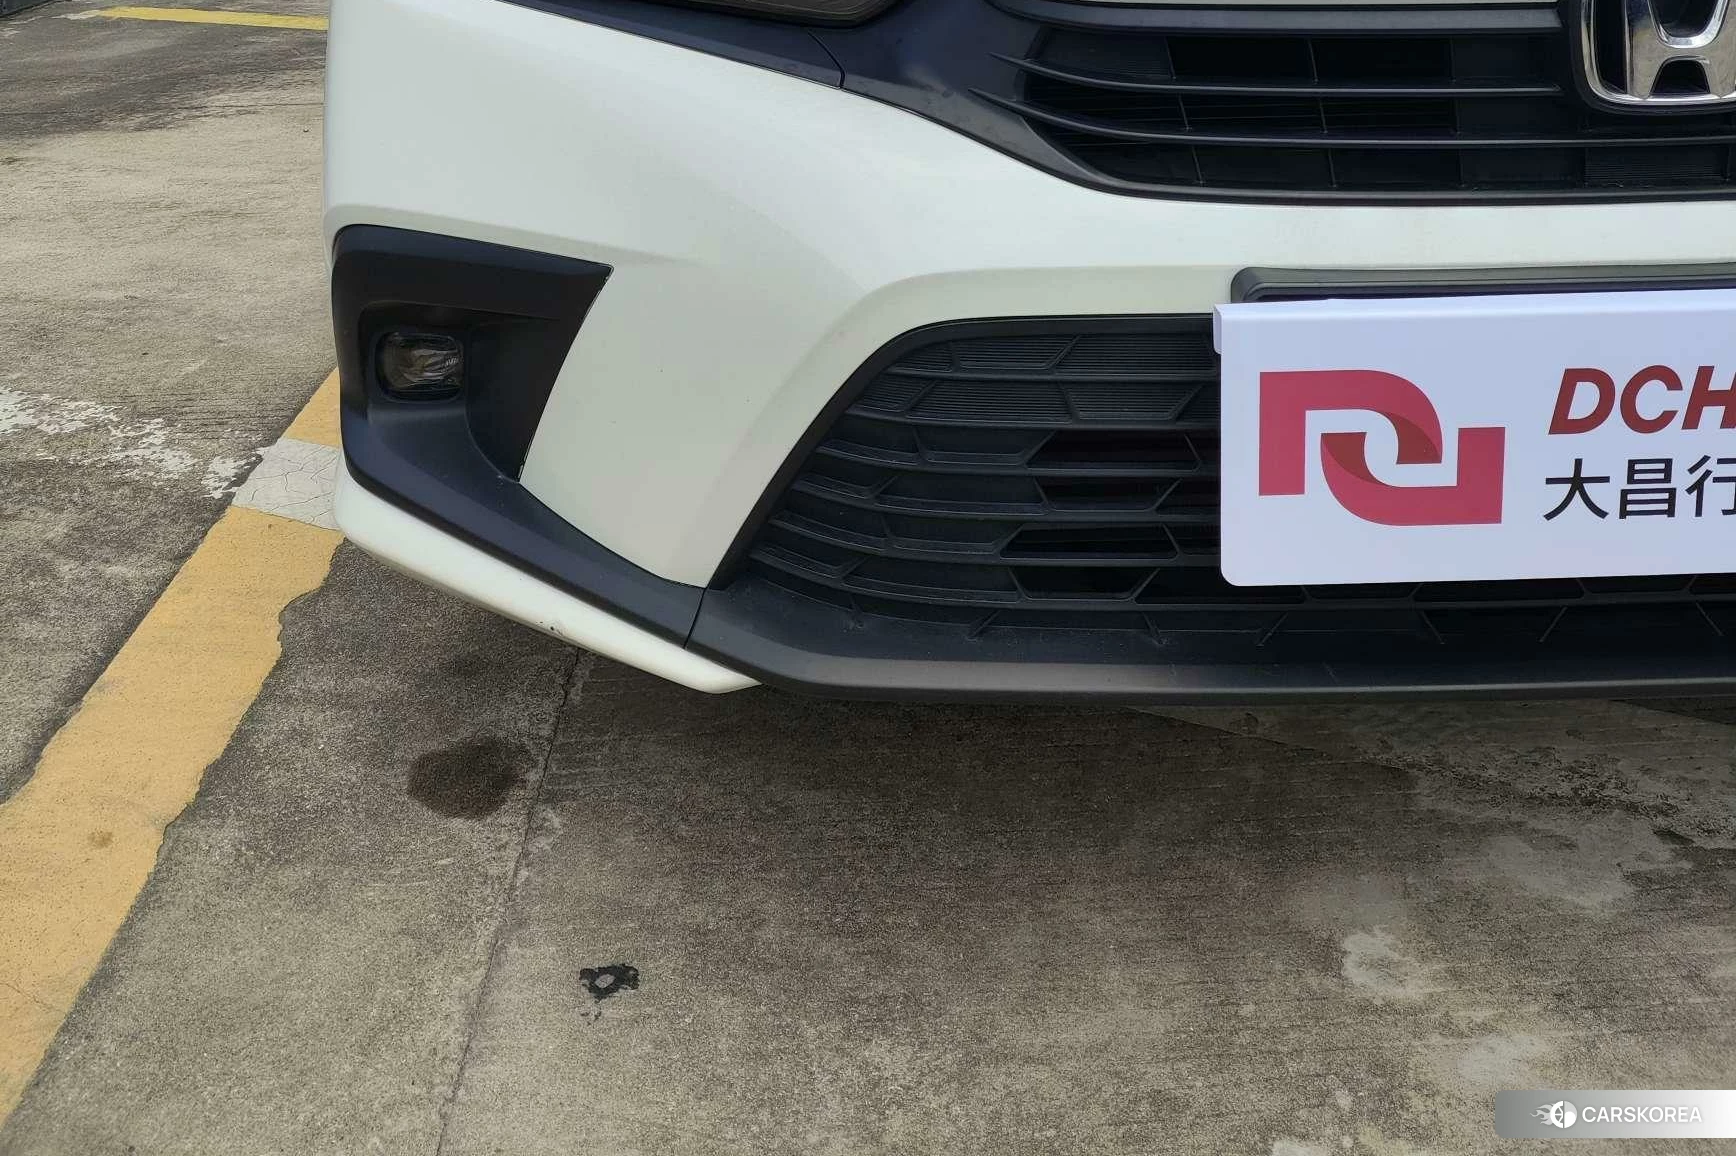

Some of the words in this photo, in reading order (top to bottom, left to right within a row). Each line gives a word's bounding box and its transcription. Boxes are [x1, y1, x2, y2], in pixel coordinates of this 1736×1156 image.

[1548, 364, 1736, 435] DCH
[1543, 454, 1736, 521] 大昌行
